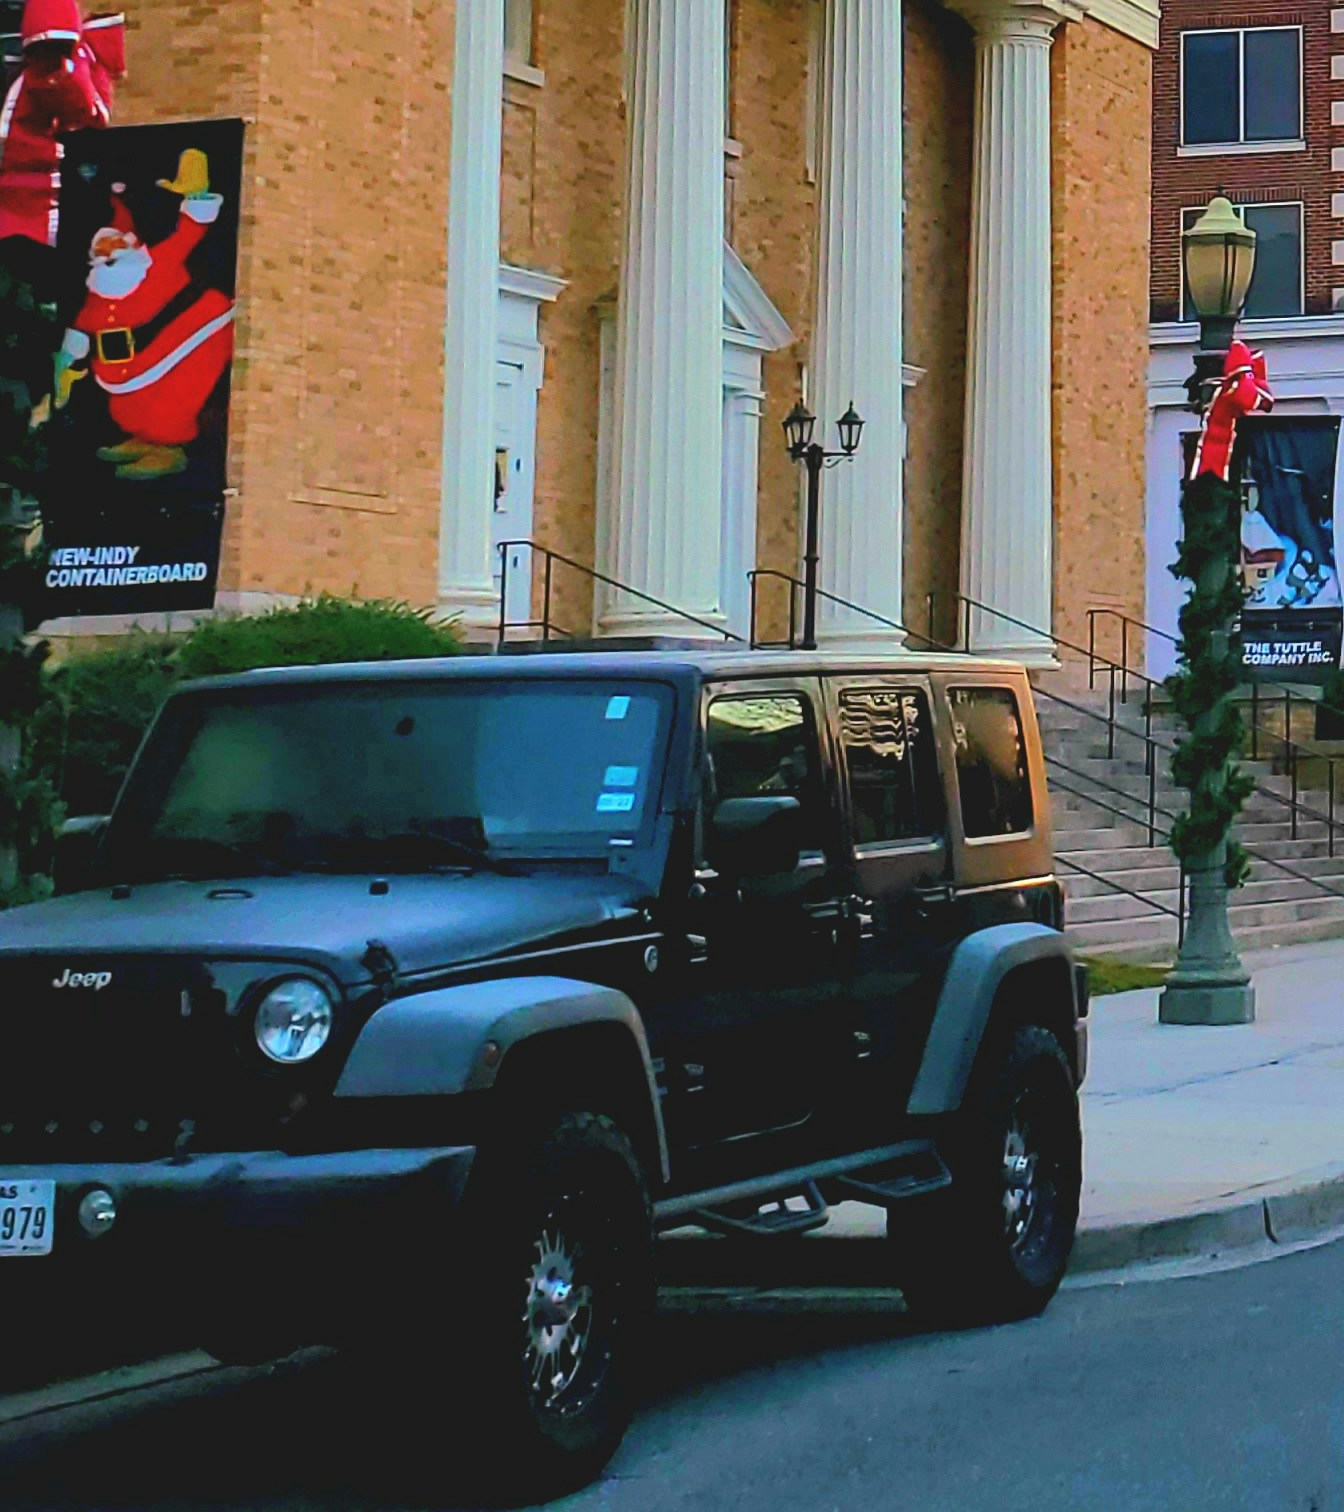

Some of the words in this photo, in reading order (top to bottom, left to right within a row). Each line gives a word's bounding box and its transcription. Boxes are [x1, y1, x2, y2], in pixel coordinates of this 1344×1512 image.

[49, 546, 140, 566] NEW-INDY
[45, 562, 207, 588] CONTAINERBOARD
[1243, 642, 1271, 654] THE
[1273, 641, 1322, 654] TUTTLE
[1242, 653, 1306, 665] COMPANY
[1307, 651, 1335, 664] INC.
[52, 968, 113, 991] Jeep
